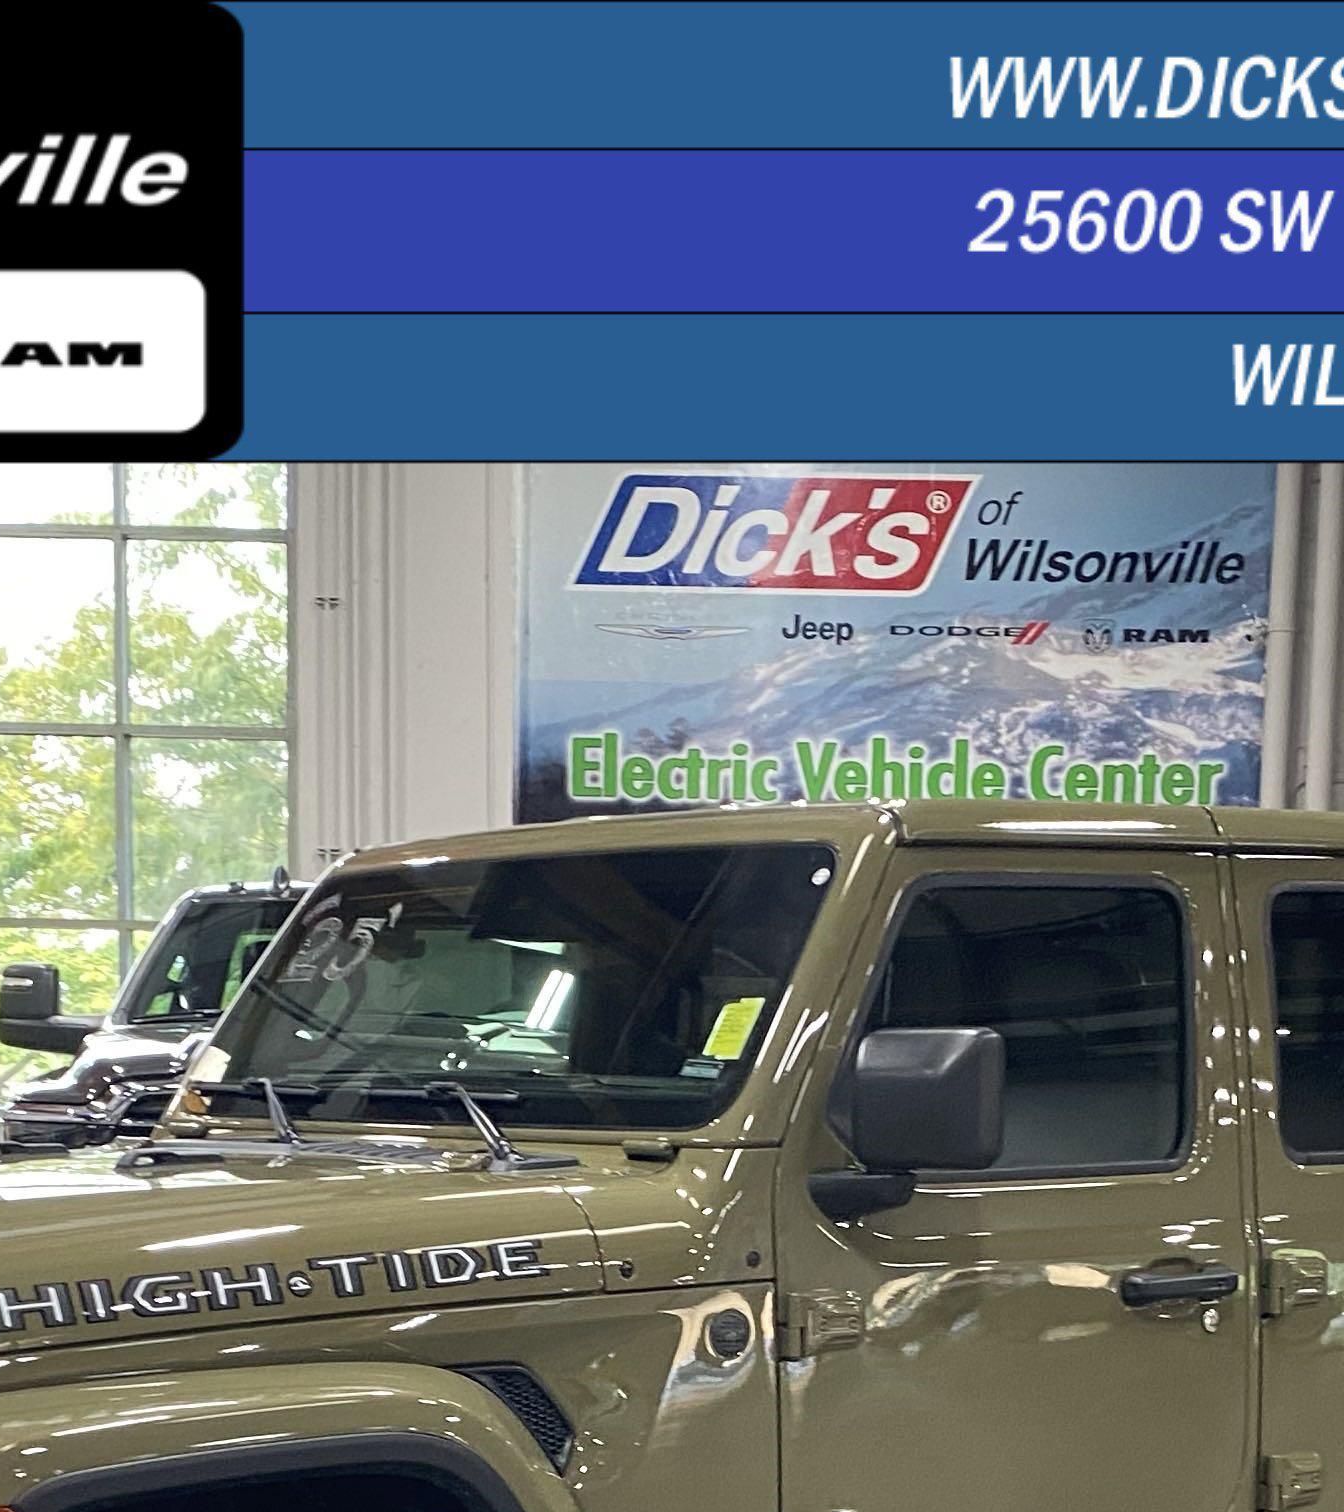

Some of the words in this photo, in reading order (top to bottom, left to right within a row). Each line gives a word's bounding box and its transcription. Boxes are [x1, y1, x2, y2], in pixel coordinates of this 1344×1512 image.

[978, 491, 1023, 526] of
[598, 485, 930, 579] Dick's
[965, 538, 1245, 584] Wilsonville
[783, 614, 853, 645] Jeep
[890, 623, 1023, 638] DODGE
[1123, 628, 1209, 643] RAM
[571, 733, 778, 801] Electric
[796, 738, 1005, 802] Vehicle
[1029, 746, 1222, 805] Center
[309, 1238, 550, 1298] TIDE
